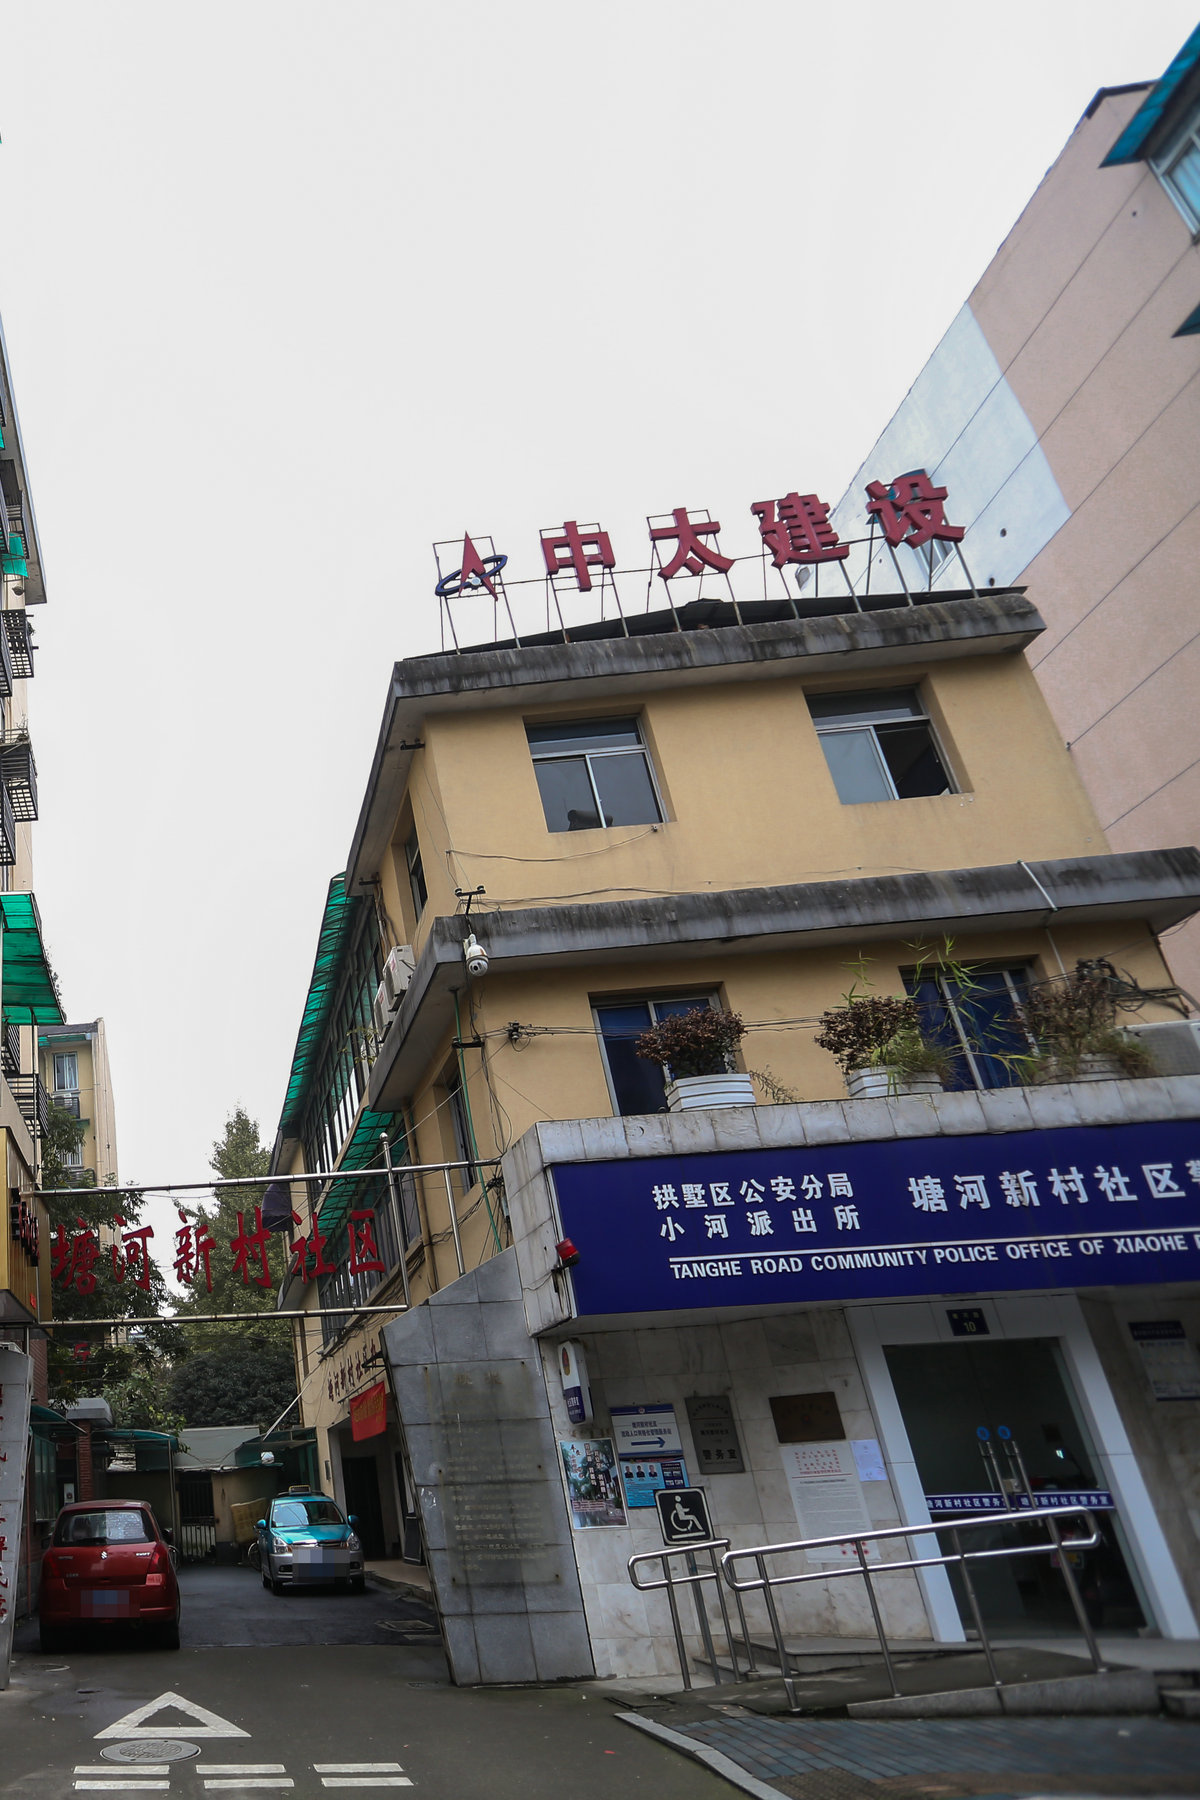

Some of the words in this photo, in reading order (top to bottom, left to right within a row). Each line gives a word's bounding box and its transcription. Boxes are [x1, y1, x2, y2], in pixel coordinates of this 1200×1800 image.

[540, 469, 965, 592] 中太建设
[652, 1173, 854, 1210] 拱墅区公安分局
[660, 1205, 861, 1242] 小河派出所
[51, 1206, 386, 1295] 塘河新村社区
[670, 1260, 742, 1279] TANGHE
[751, 1258, 803, 1275] ROAD
[811, 1250, 927, 1271] COMMUNITY
[934, 1246, 998, 1264] POLICE
[1006, 1242, 1071, 1260] OFFICE
[1079, 1239, 1104, 1255] OF
[1114, 1235, 1188, 1254] XIAOHE
[963, 1321, 977, 1333] 10
[927, 1497, 1006, 1509] 塘河新村社区警务
